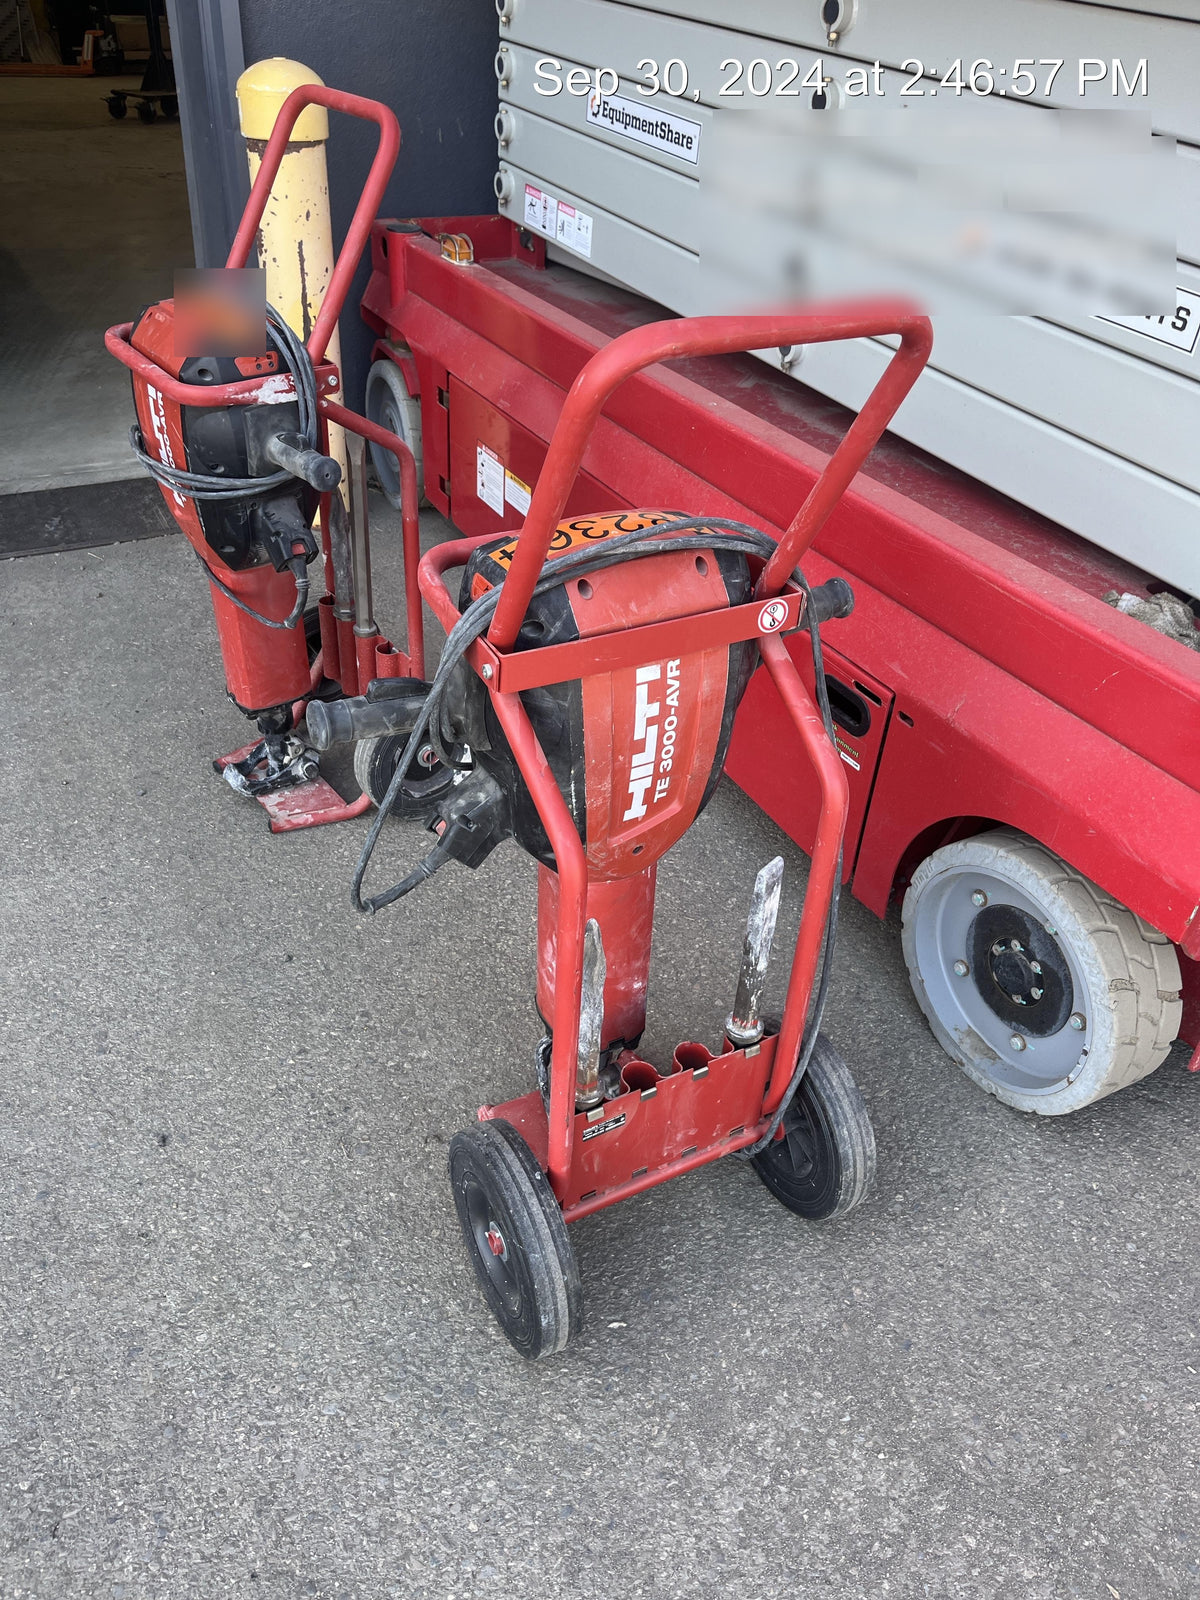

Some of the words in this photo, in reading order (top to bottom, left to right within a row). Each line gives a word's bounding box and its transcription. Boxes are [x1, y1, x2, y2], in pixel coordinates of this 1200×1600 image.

[602, 100, 694, 150] EquipmentShare
[622, 663, 662, 822] HILTI
[659, 658, 681, 777] 3000-AVR
[653, 776, 671, 803] TE
